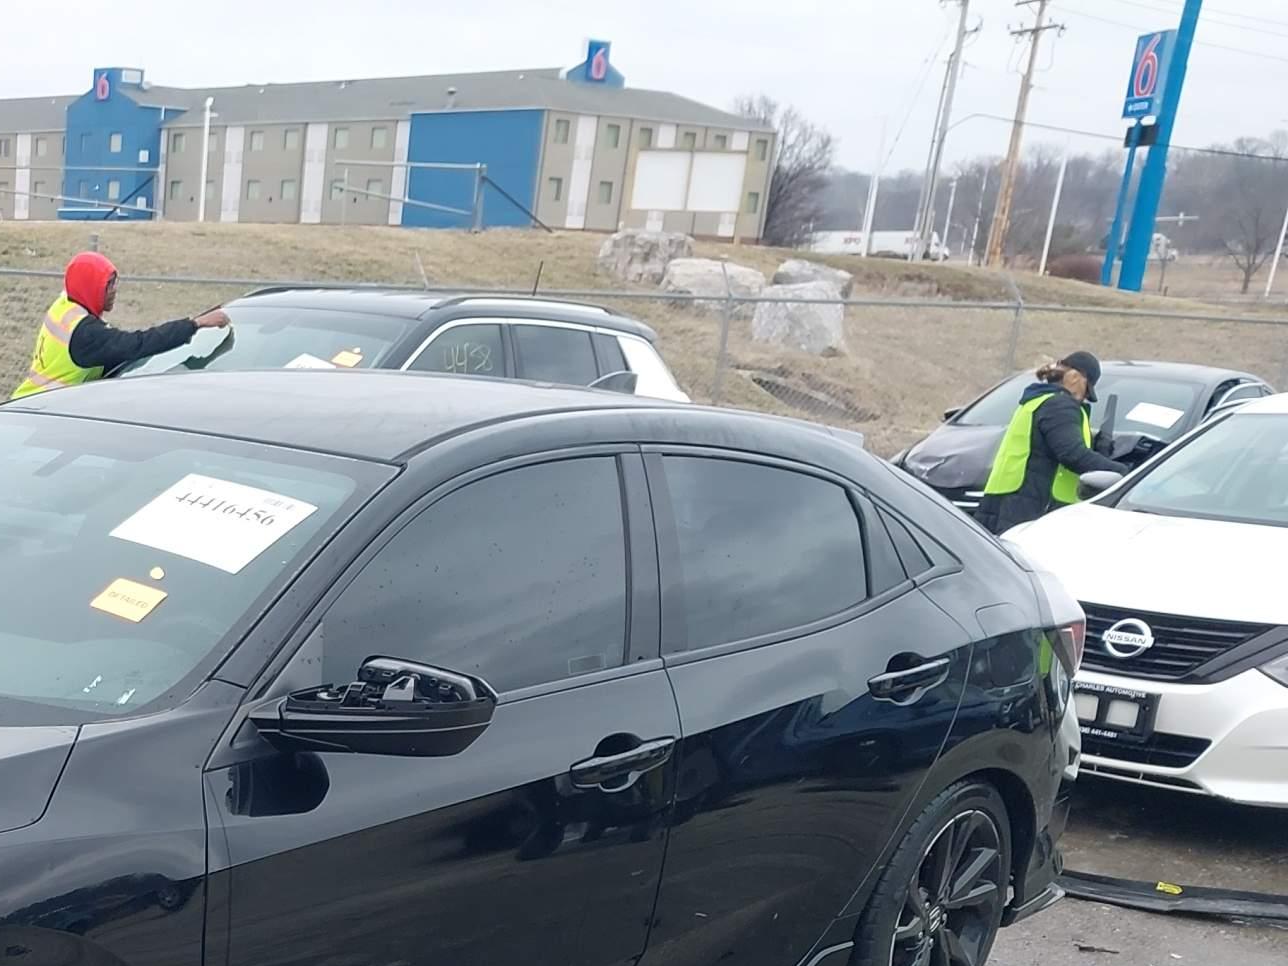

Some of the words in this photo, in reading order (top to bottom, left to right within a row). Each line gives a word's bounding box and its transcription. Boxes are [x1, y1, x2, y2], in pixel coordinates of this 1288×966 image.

[592, 47, 606, 80] 6
[1134, 33, 1161, 98] 6
[97, 71, 110, 100] 6
[175, 492, 277, 526] 44416456
[1106, 632, 1147, 646] NISSAN
